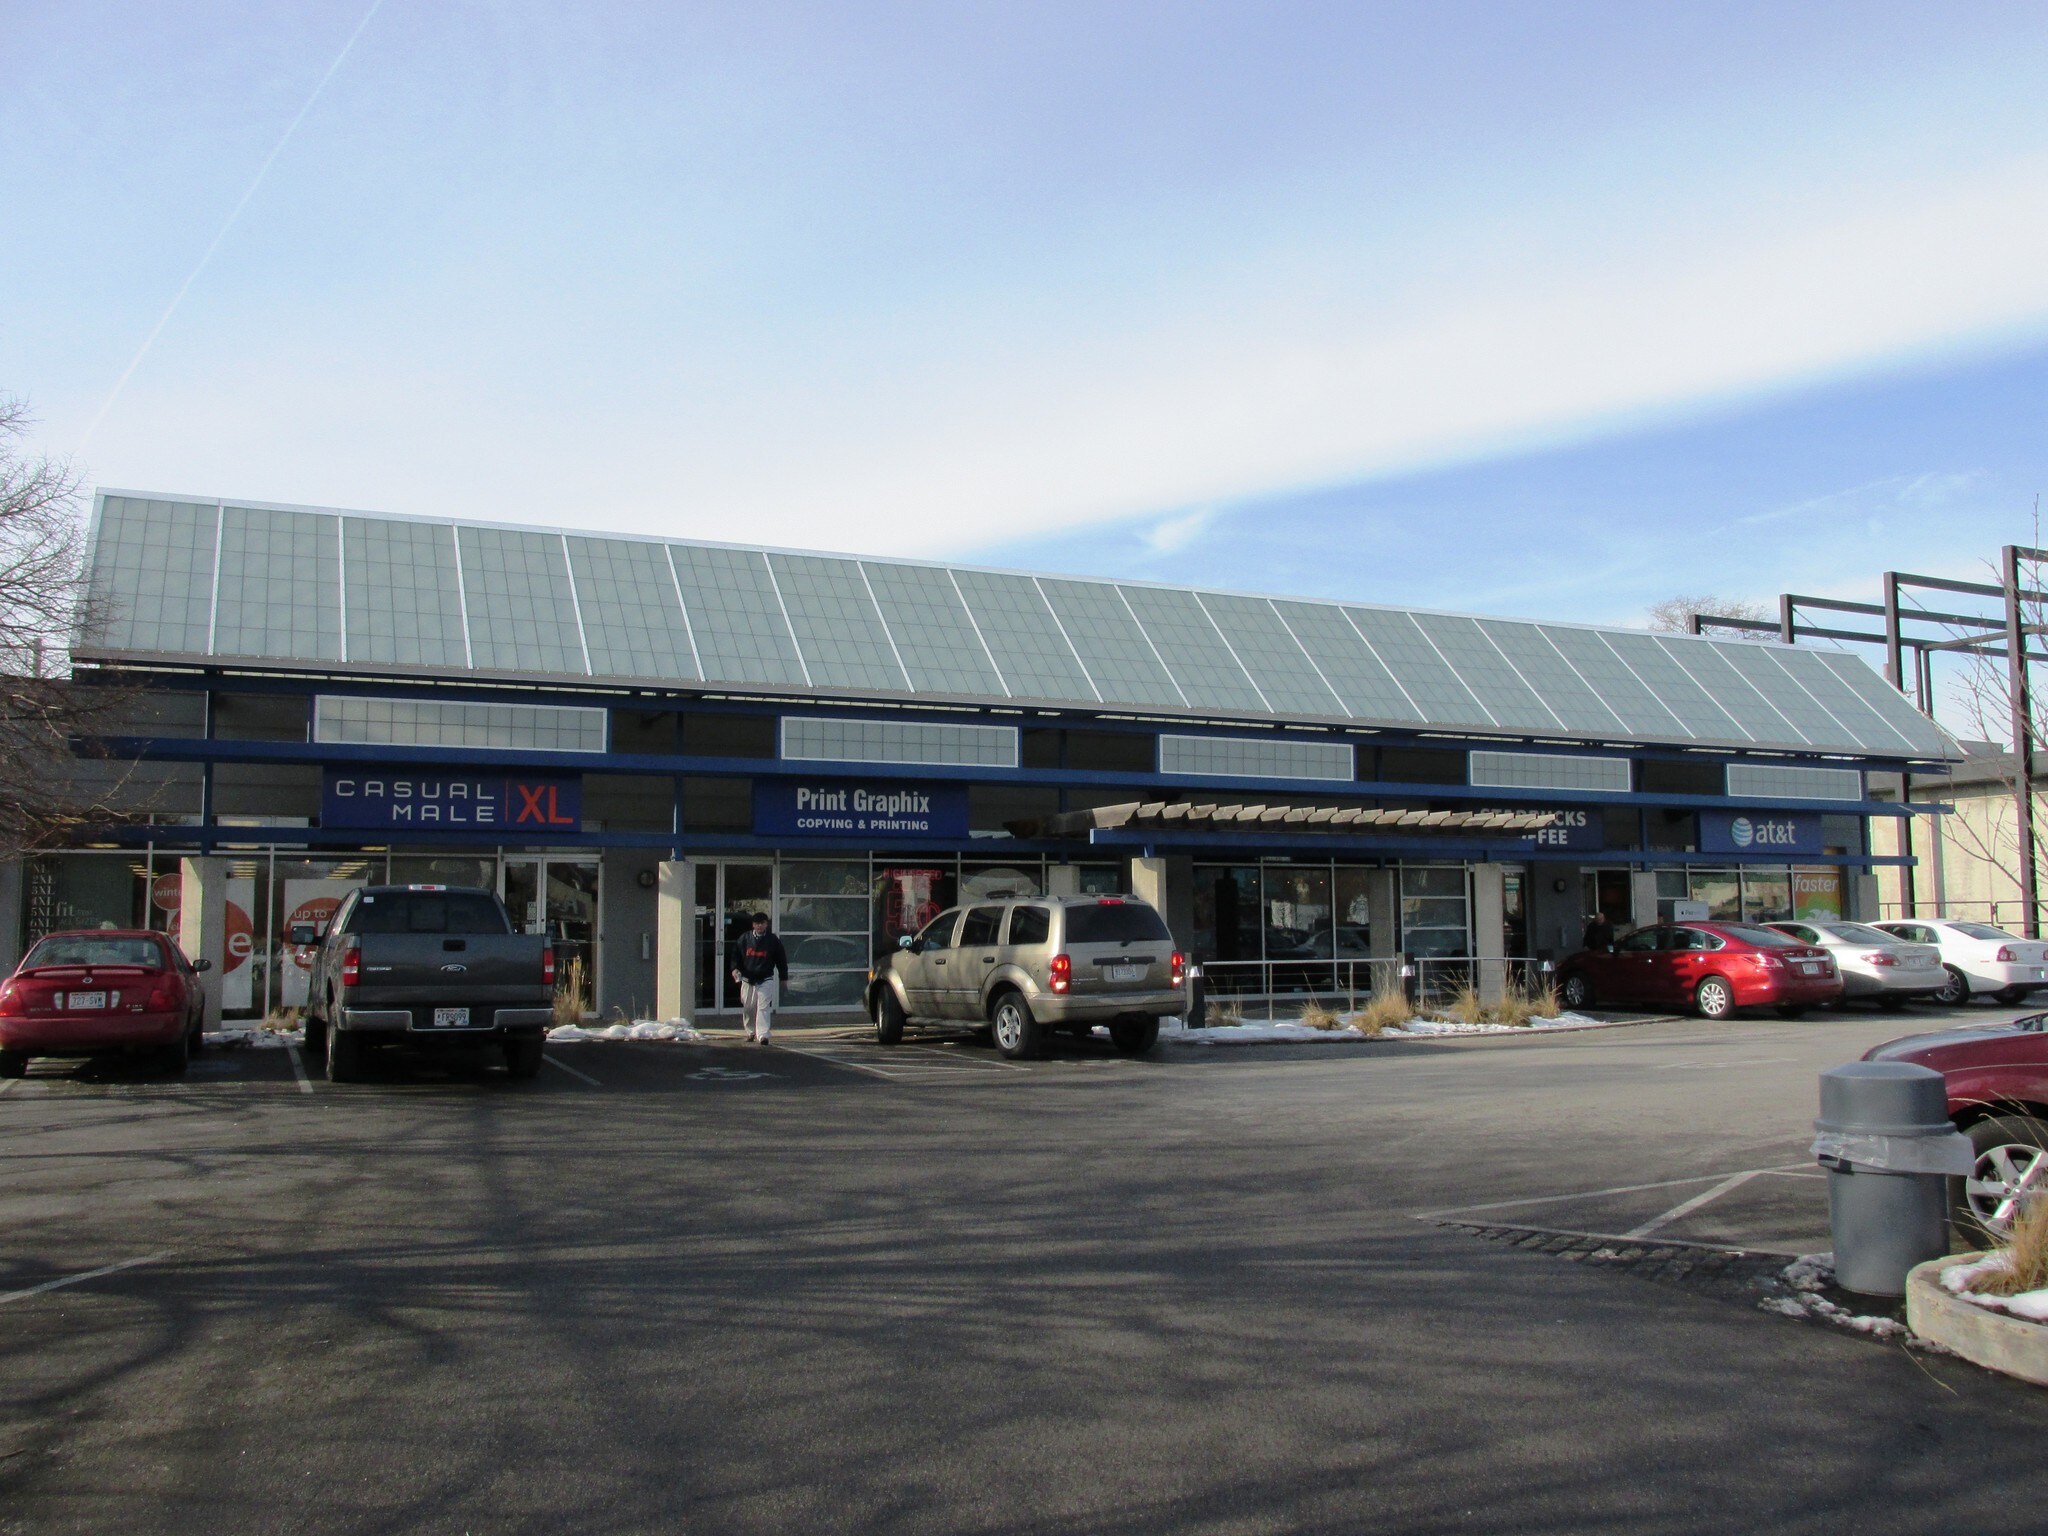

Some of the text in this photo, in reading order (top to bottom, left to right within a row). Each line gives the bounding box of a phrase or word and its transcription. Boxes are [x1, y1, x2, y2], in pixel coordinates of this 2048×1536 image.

[336, 780, 495, 800] CASUAL
[516, 784, 574, 824] XL
[797, 787, 930, 817] Print Graphix
[392, 804, 495, 822] MALE
[797, 818, 929, 830] COPYING & PRINTING
[1755, 820, 1797, 844] at&t
[32, 875, 56, 885] 2XL
[1794, 874, 1839, 892] faster
[31, 885, 56, 895] 3XL
[31, 907, 54, 917] 5XL
[55, 901, 75, 917] fit
[294, 908, 328, 920] up to
[30, 918, 54, 928] 6XL
